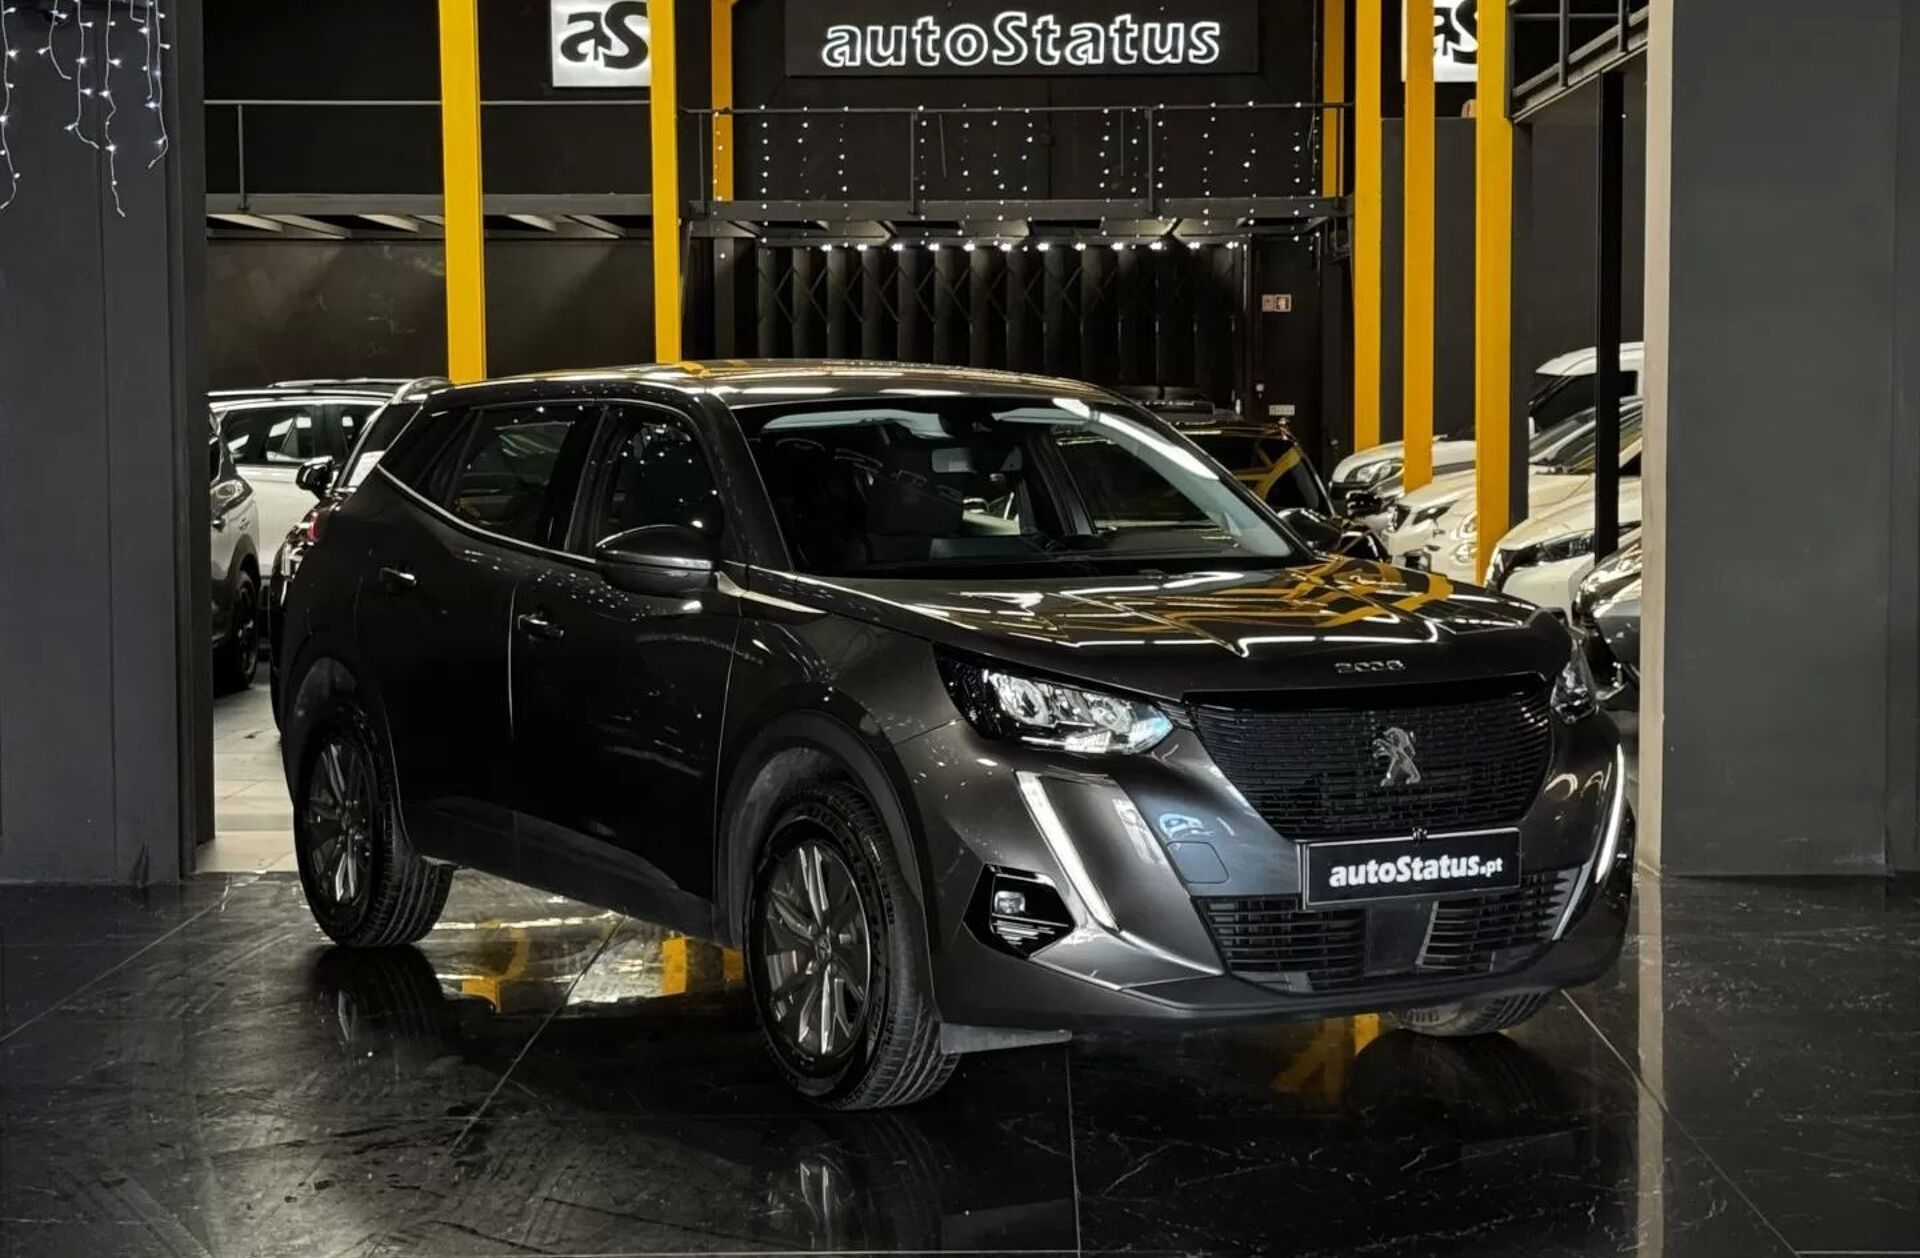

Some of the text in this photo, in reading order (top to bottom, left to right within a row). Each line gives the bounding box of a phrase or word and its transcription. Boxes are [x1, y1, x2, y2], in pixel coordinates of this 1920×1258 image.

[561, 1, 649, 70] aS
[821, 10, 1221, 68] autoStatus
[1328, 854, 1504, 888] autoStatus.pt
